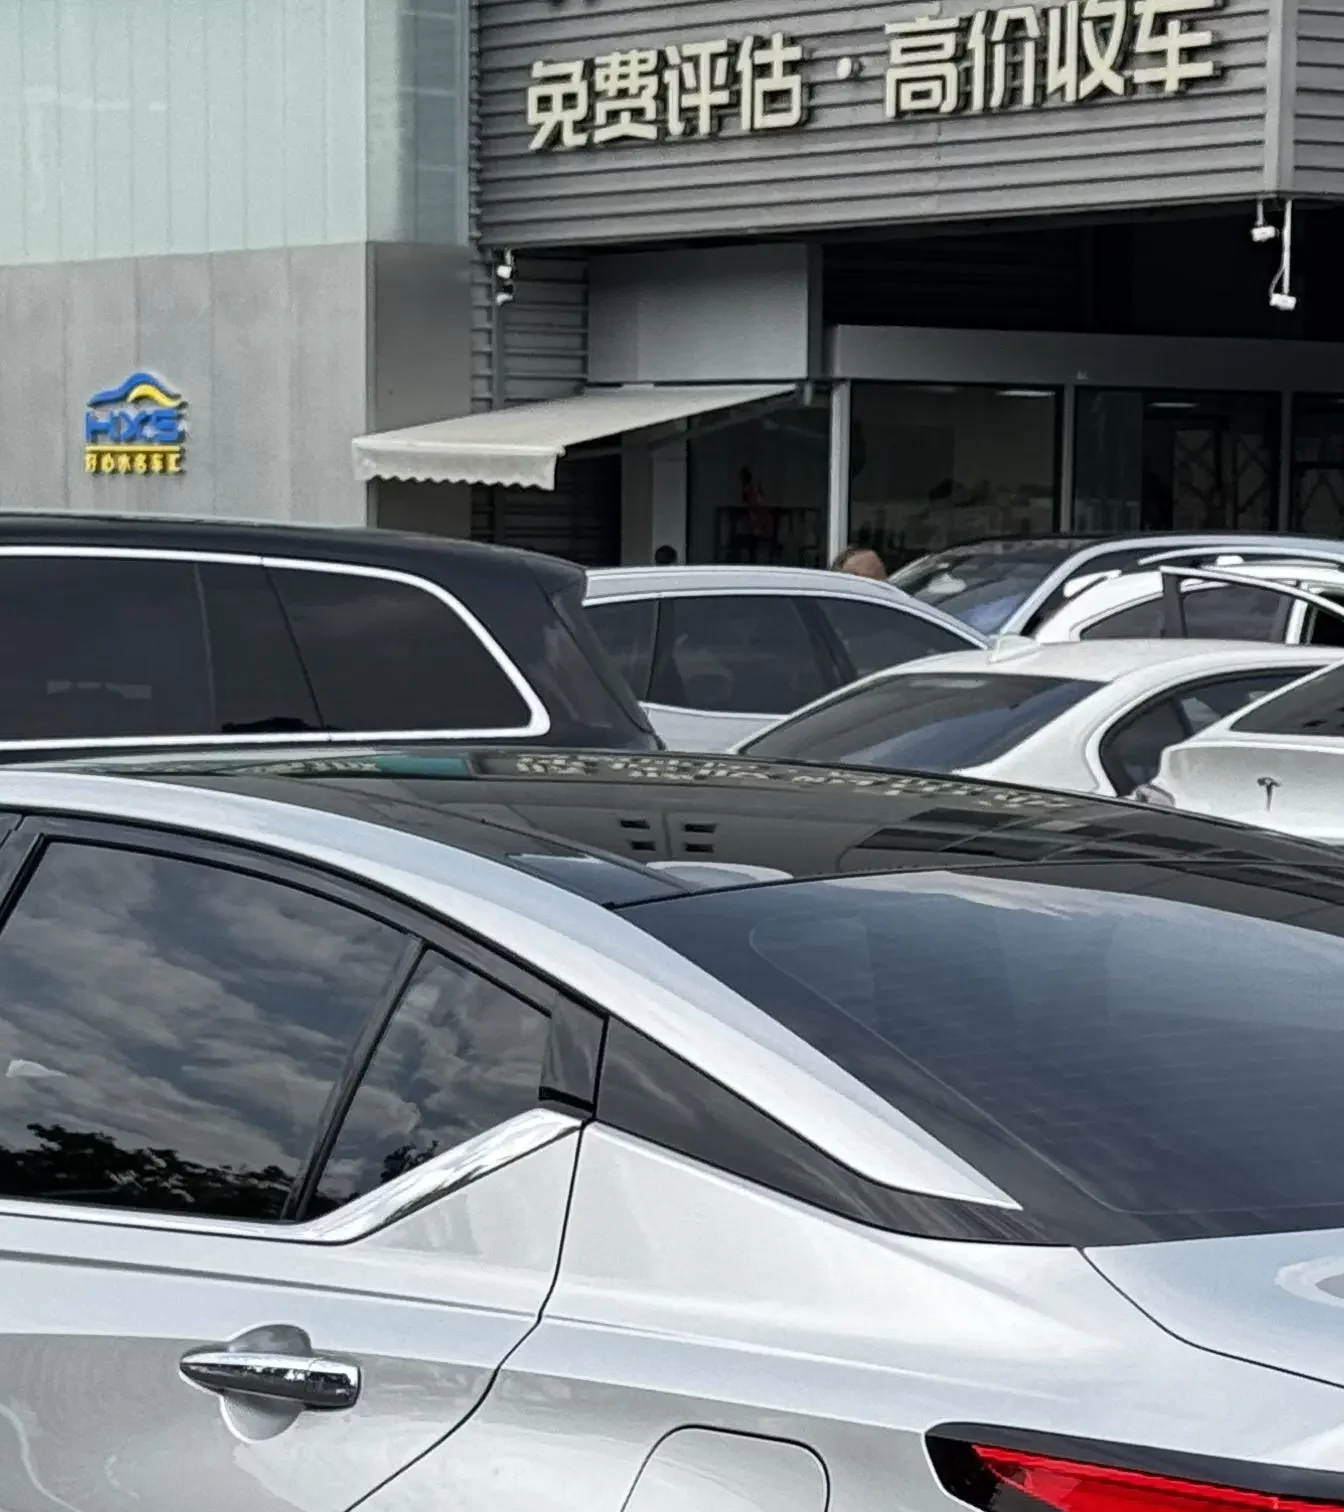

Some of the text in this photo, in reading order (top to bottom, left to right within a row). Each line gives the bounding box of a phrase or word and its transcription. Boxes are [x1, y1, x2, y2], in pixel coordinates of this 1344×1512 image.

[524, 0, 1217, 151] 免费评估·高价收车
[84, 408, 181, 443] HXS
